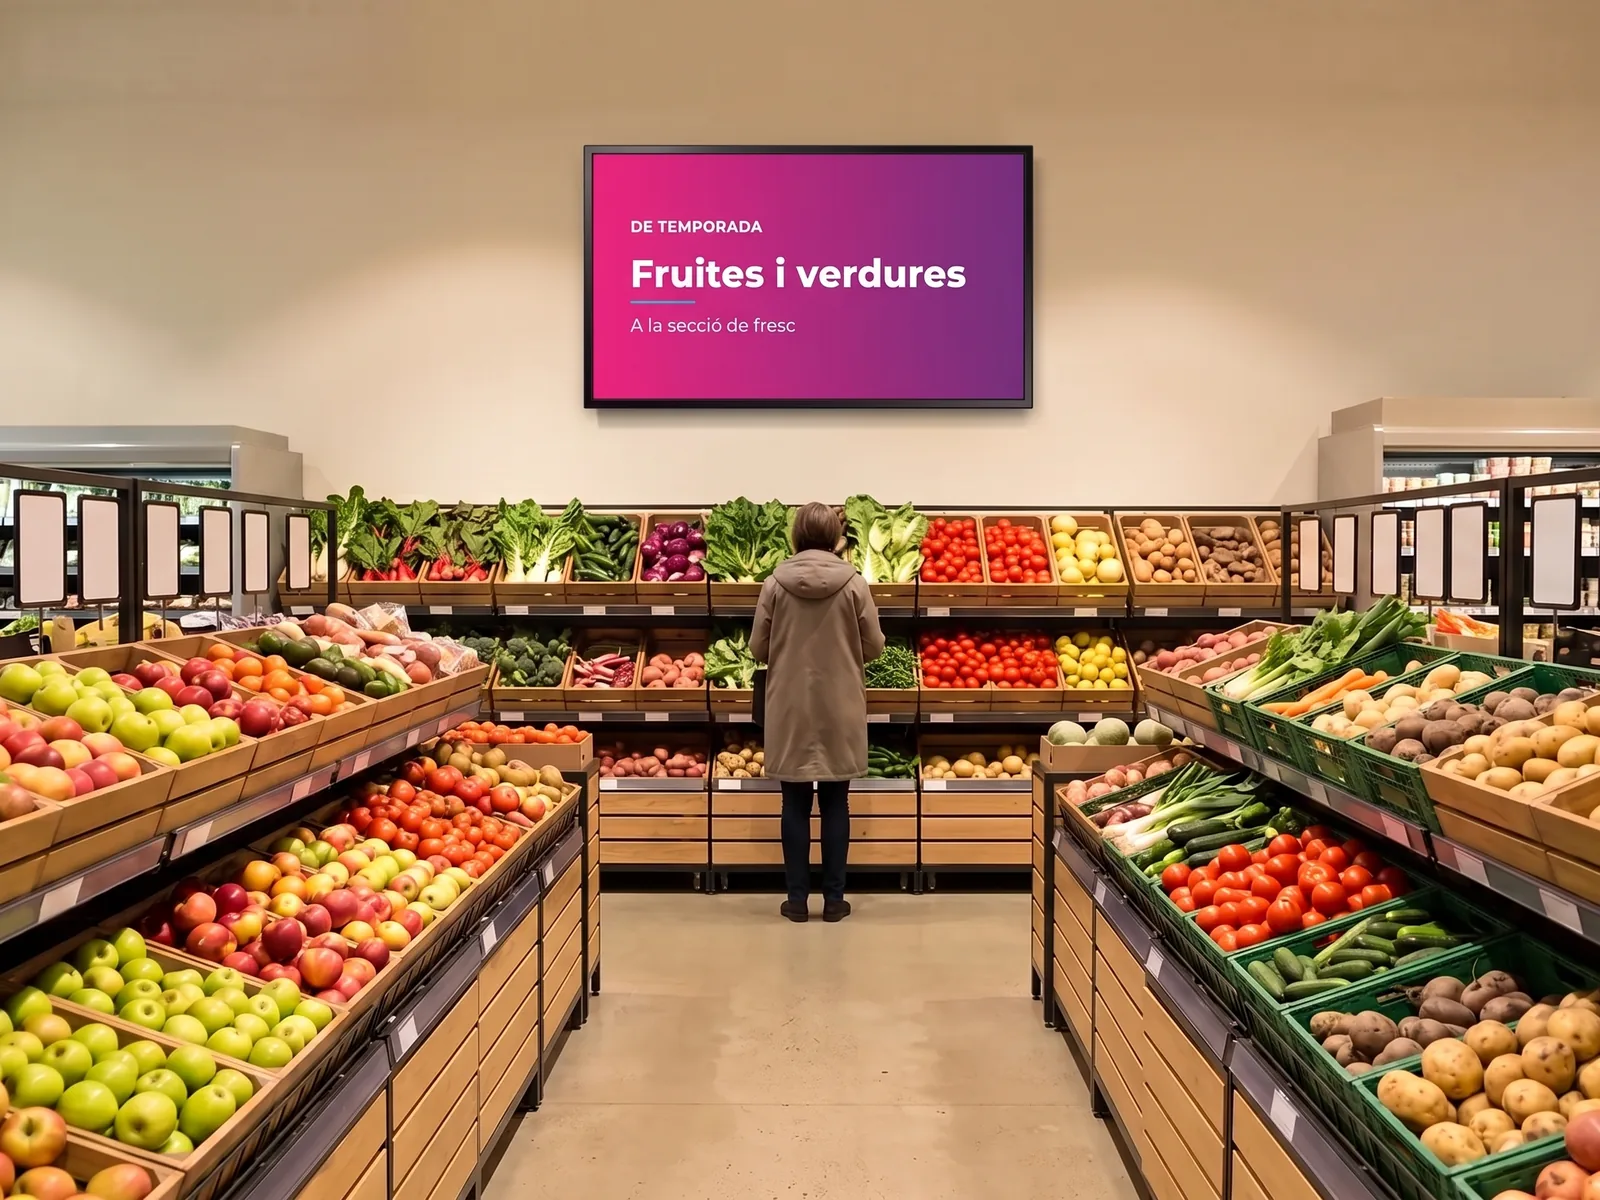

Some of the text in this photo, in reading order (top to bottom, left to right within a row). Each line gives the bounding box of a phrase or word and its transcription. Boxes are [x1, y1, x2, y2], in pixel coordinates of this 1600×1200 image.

[631, 220, 763, 233] DE TEMPORADA
[632, 257, 967, 289] Fruites i verdures
[630, 317, 796, 333] A la secció de fresc
